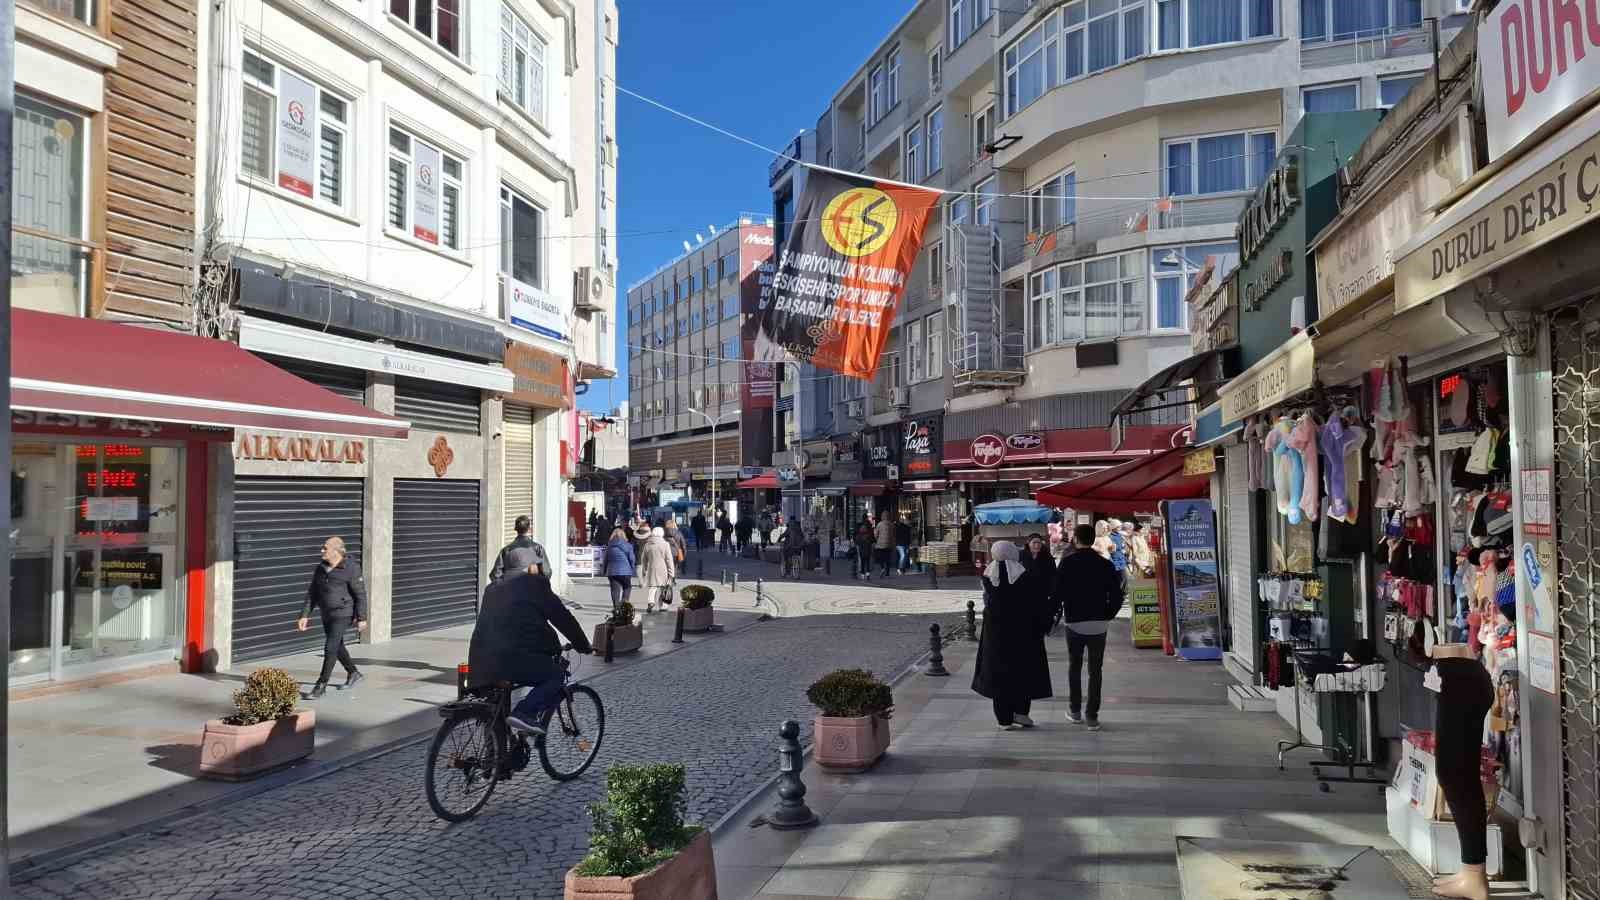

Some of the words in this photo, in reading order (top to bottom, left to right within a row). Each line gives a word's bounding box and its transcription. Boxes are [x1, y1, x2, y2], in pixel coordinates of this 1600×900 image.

[1431, 216, 1497, 281] DURUL
[1503, 163, 1567, 245] DERİ
[780, 249, 858, 279] ŞAMPİYONLUK
[775, 295, 841, 321] BAŞARILAR
[235, 431, 365, 464] ALKARALAR
[1175, 551, 1213, 561] BURADA
